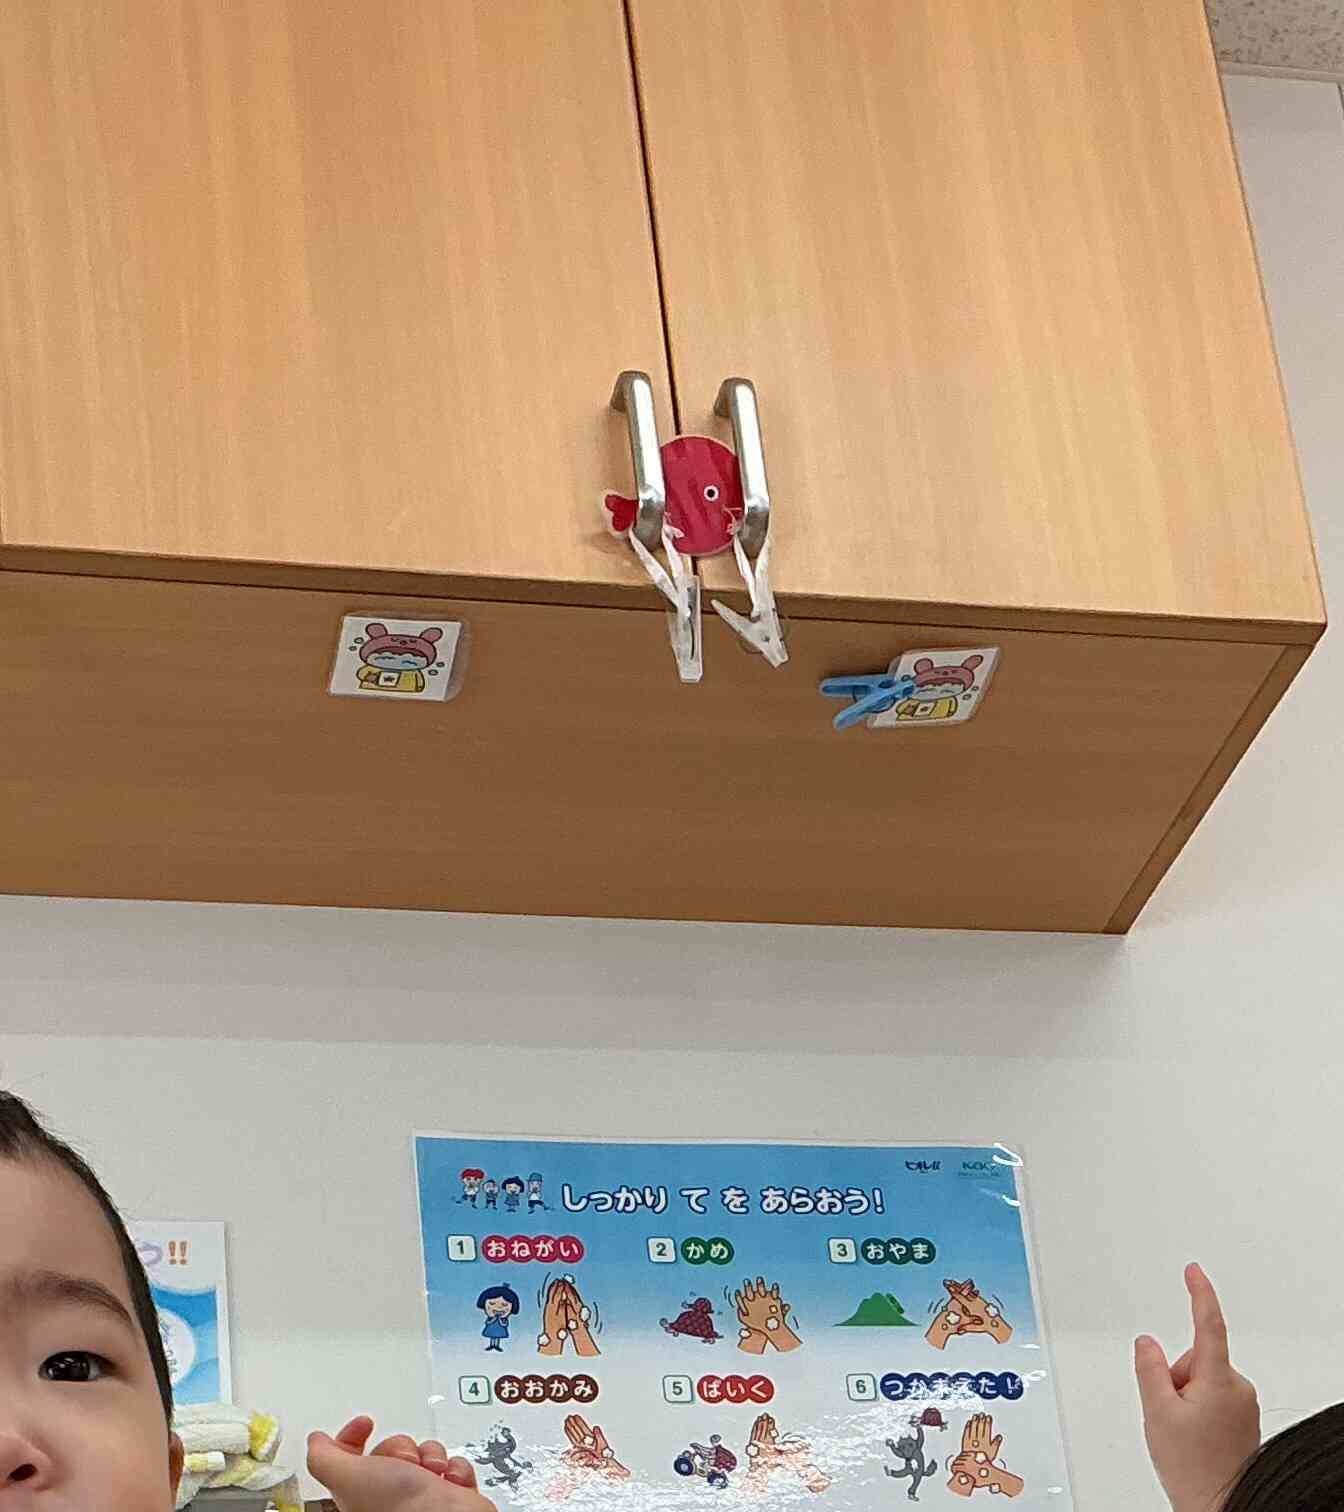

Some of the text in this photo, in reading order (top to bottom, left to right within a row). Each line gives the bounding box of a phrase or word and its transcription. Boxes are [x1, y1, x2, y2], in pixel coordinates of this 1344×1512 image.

[561, 1184, 885, 1215] しっかり て を あらおう!
[456, 1240, 579, 1257] 1 おねがい
[656, 1242, 728, 1260] 2 かめ
[837, 1243, 929, 1260] 3 おやま
[469, 1380, 594, 1398] 4 おおかみ
[672, 1380, 766, 1397] 5 ばいく
[855, 1380, 866, 1393] 6
